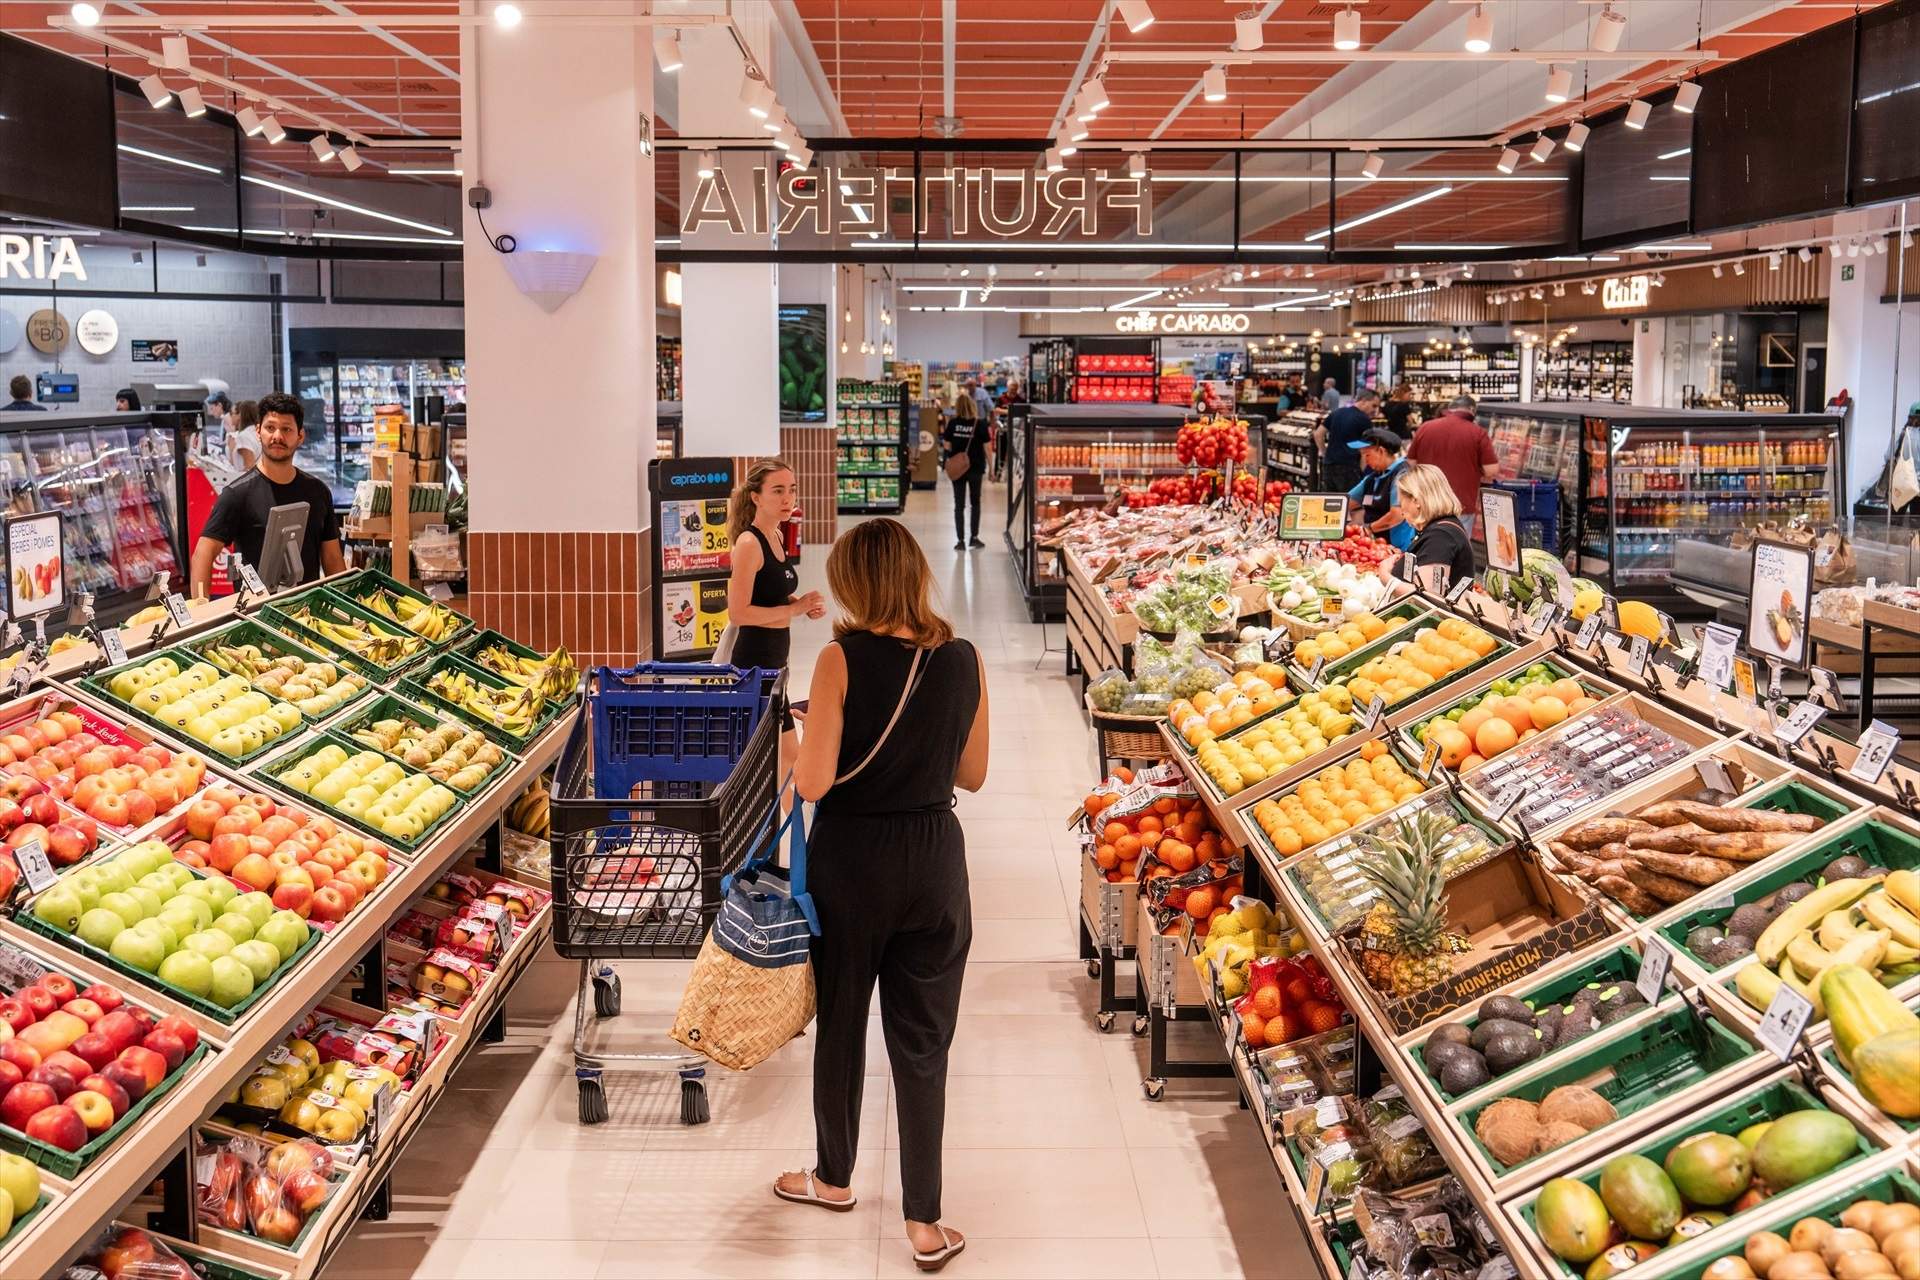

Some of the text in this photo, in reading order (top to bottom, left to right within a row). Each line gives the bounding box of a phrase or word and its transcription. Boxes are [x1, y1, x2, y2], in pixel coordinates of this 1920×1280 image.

[1115, 313, 1250, 333] CHEF CAPRABO
[671, 473, 706, 486] caprabo
[707, 506, 726, 514] OFERTA
[11, 523, 38, 538] ESPECIAL
[33, 535, 54, 549] POMES
[705, 532, 728, 550] 3,49
[702, 590, 726, 598] OFERTA
[1454, 946, 1542, 998] HONEYGLOW
